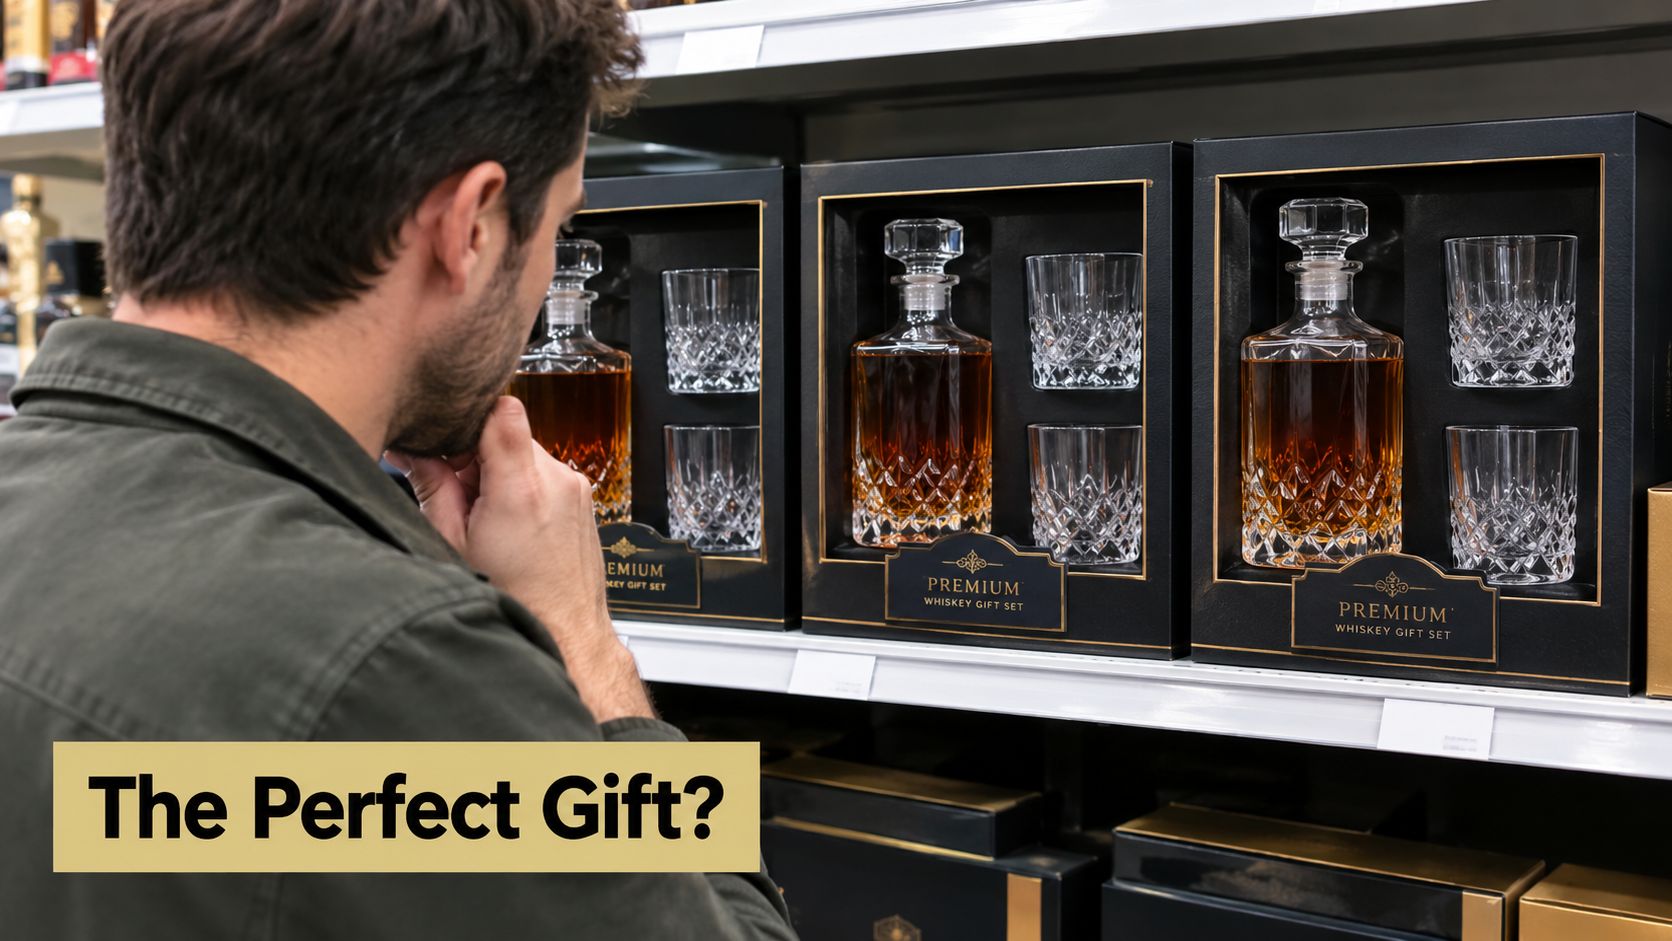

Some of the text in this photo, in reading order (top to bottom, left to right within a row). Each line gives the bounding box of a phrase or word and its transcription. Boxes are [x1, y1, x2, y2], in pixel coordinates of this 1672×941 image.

[607, 562, 663, 577] EMIUM
[627, 581, 647, 590] GIFT
[649, 583, 667, 591] SET
[928, 577, 1019, 596] PREMIUM
[924, 597, 1024, 611] WHISKEY GIFT SET
[1339, 601, 1446, 623] PREMIUM
[1335, 623, 1451, 640] WHISKEY GIFT SET
